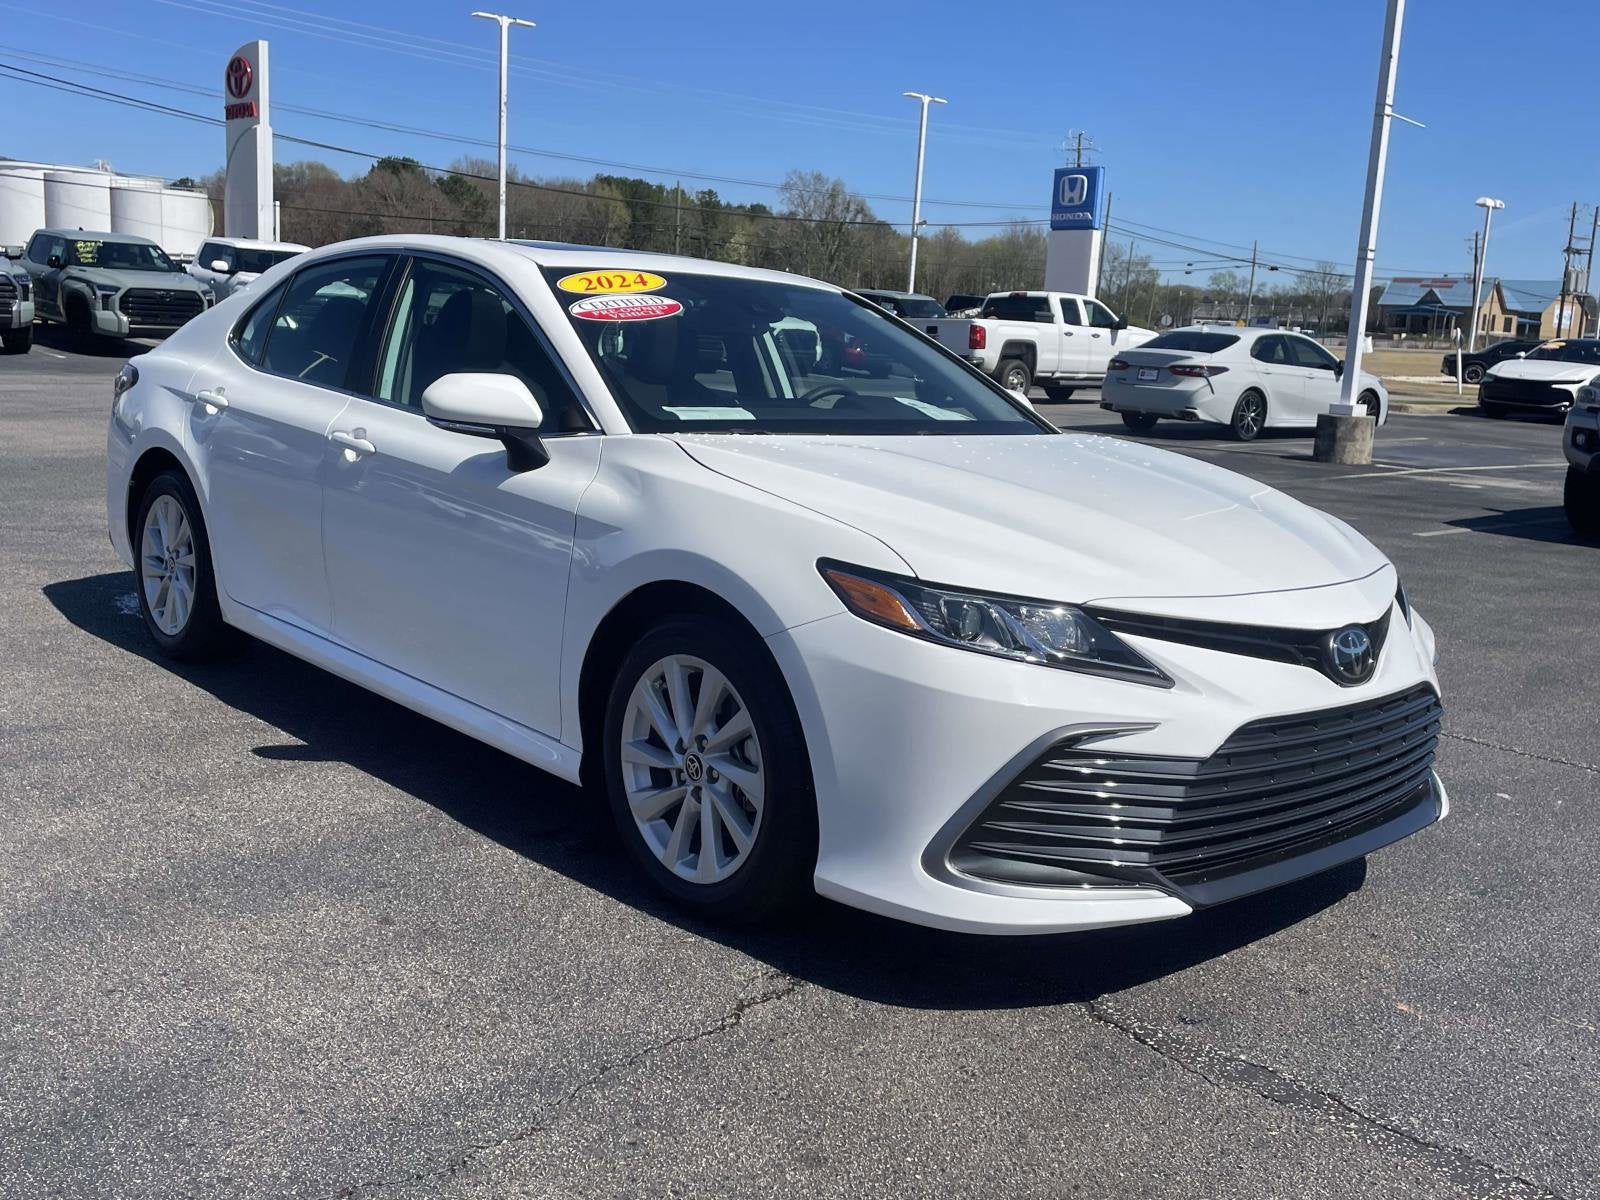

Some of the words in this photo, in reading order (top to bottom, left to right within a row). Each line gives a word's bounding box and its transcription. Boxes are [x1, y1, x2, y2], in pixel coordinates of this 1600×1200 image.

[1051, 211, 1093, 220] HONDA
[578, 273, 649, 291] 2024
[578, 295, 665, 311] CERTIFIED
[608, 310, 664, 318] VEHICLE
